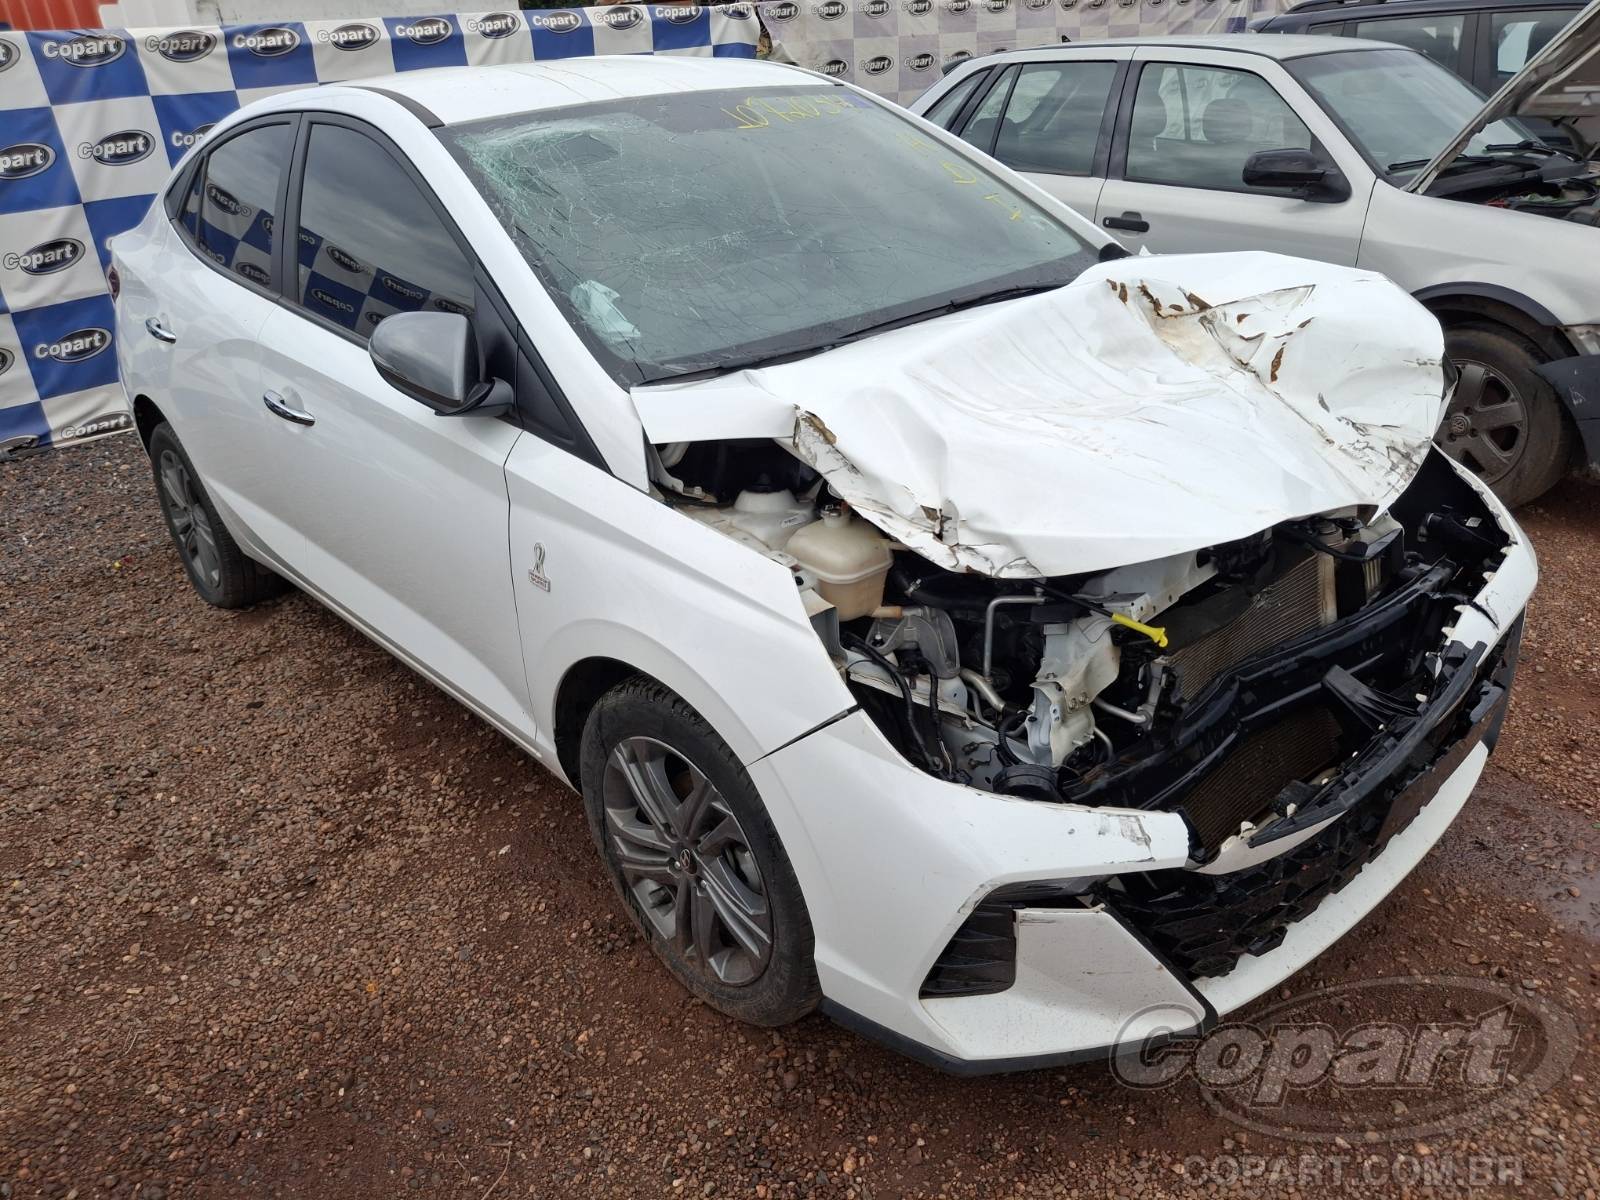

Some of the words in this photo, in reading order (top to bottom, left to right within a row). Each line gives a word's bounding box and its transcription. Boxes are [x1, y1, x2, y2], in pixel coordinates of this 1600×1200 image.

[655, 6, 698, 19] Copart
[764, 5, 798, 20] Copart
[812, 2, 846, 17] Copart
[858, 1, 892, 15] Copart
[902, 0, 931, 13] Copart
[532, 14, 577, 30] Copart
[594, 8, 639, 24] Copart
[395, 23, 446, 39] Copart
[467, 15, 515, 34] Copart
[145, 34, 207, 55] Copart
[232, 32, 292, 50] Copart
[317, 29, 373, 46] Copart
[42, 39, 118, 60] Copart
[814, 63, 845, 76] Copart
[860, 57, 891, 73] Copart
[904, 54, 934, 69] Copart
[78, 136, 147, 159] Copart
[0, 149, 43, 173] part
[3, 243, 74, 270] Copart
[35, 333, 101, 358] Copart
